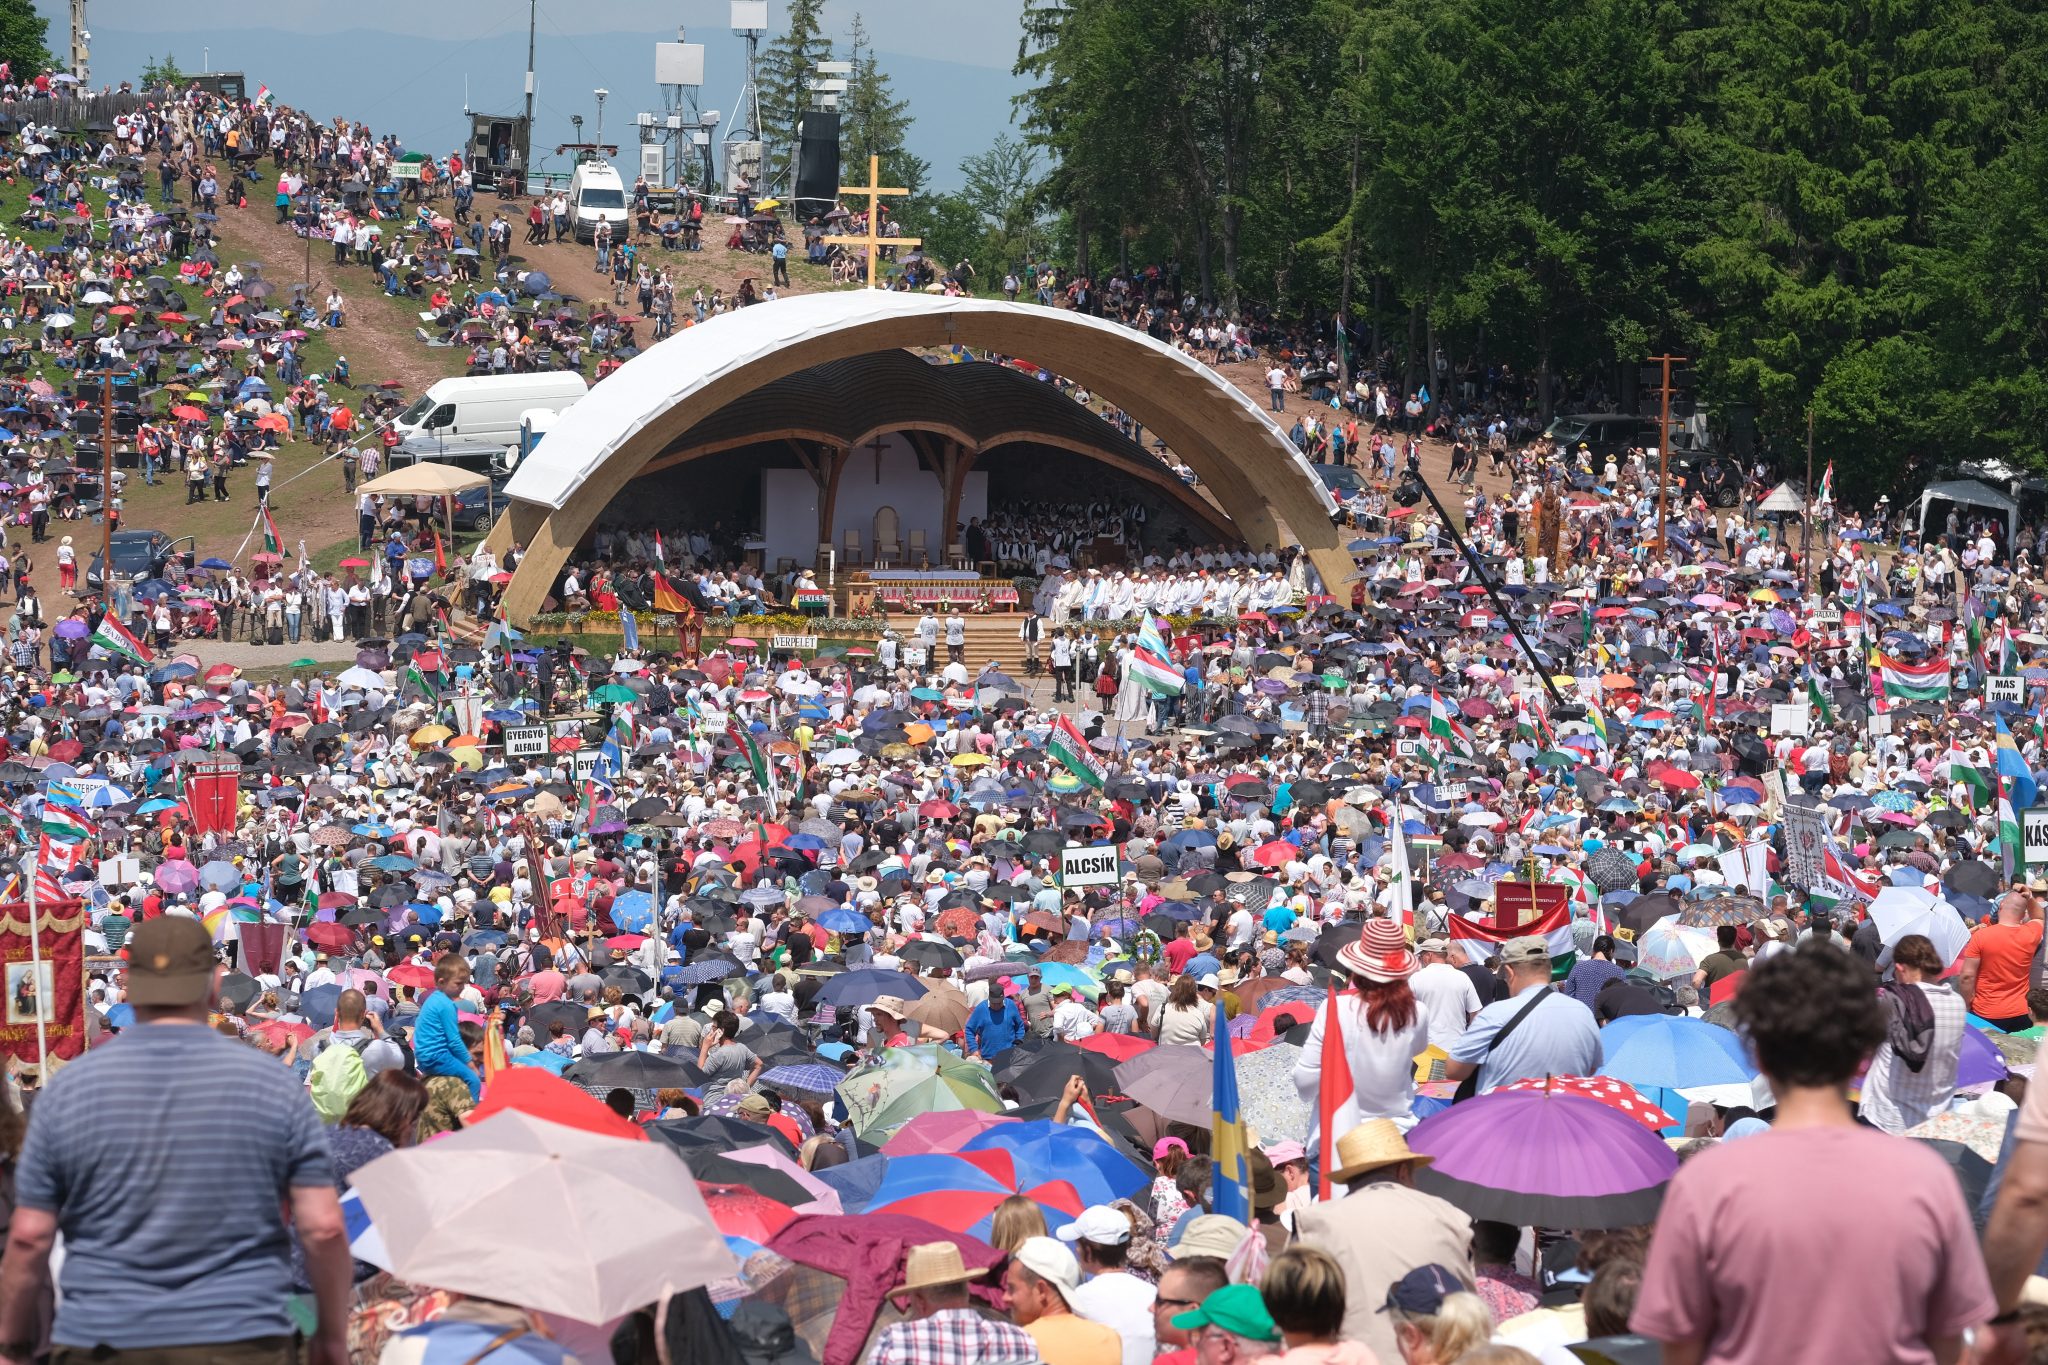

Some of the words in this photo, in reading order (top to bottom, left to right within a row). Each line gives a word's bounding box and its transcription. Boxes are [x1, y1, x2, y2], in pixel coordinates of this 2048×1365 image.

[398, 166, 419, 175] DEBRECEN
[1995, 678, 2016, 689] MÁS
[1991, 690, 2018, 702] TÁJAK
[507, 727, 547, 741] GYERGYÓ-
[514, 742, 542, 753] ALFALU
[2025, 820, 2048, 847] KÁS
[1065, 853, 1115, 875] ALCSÍK
